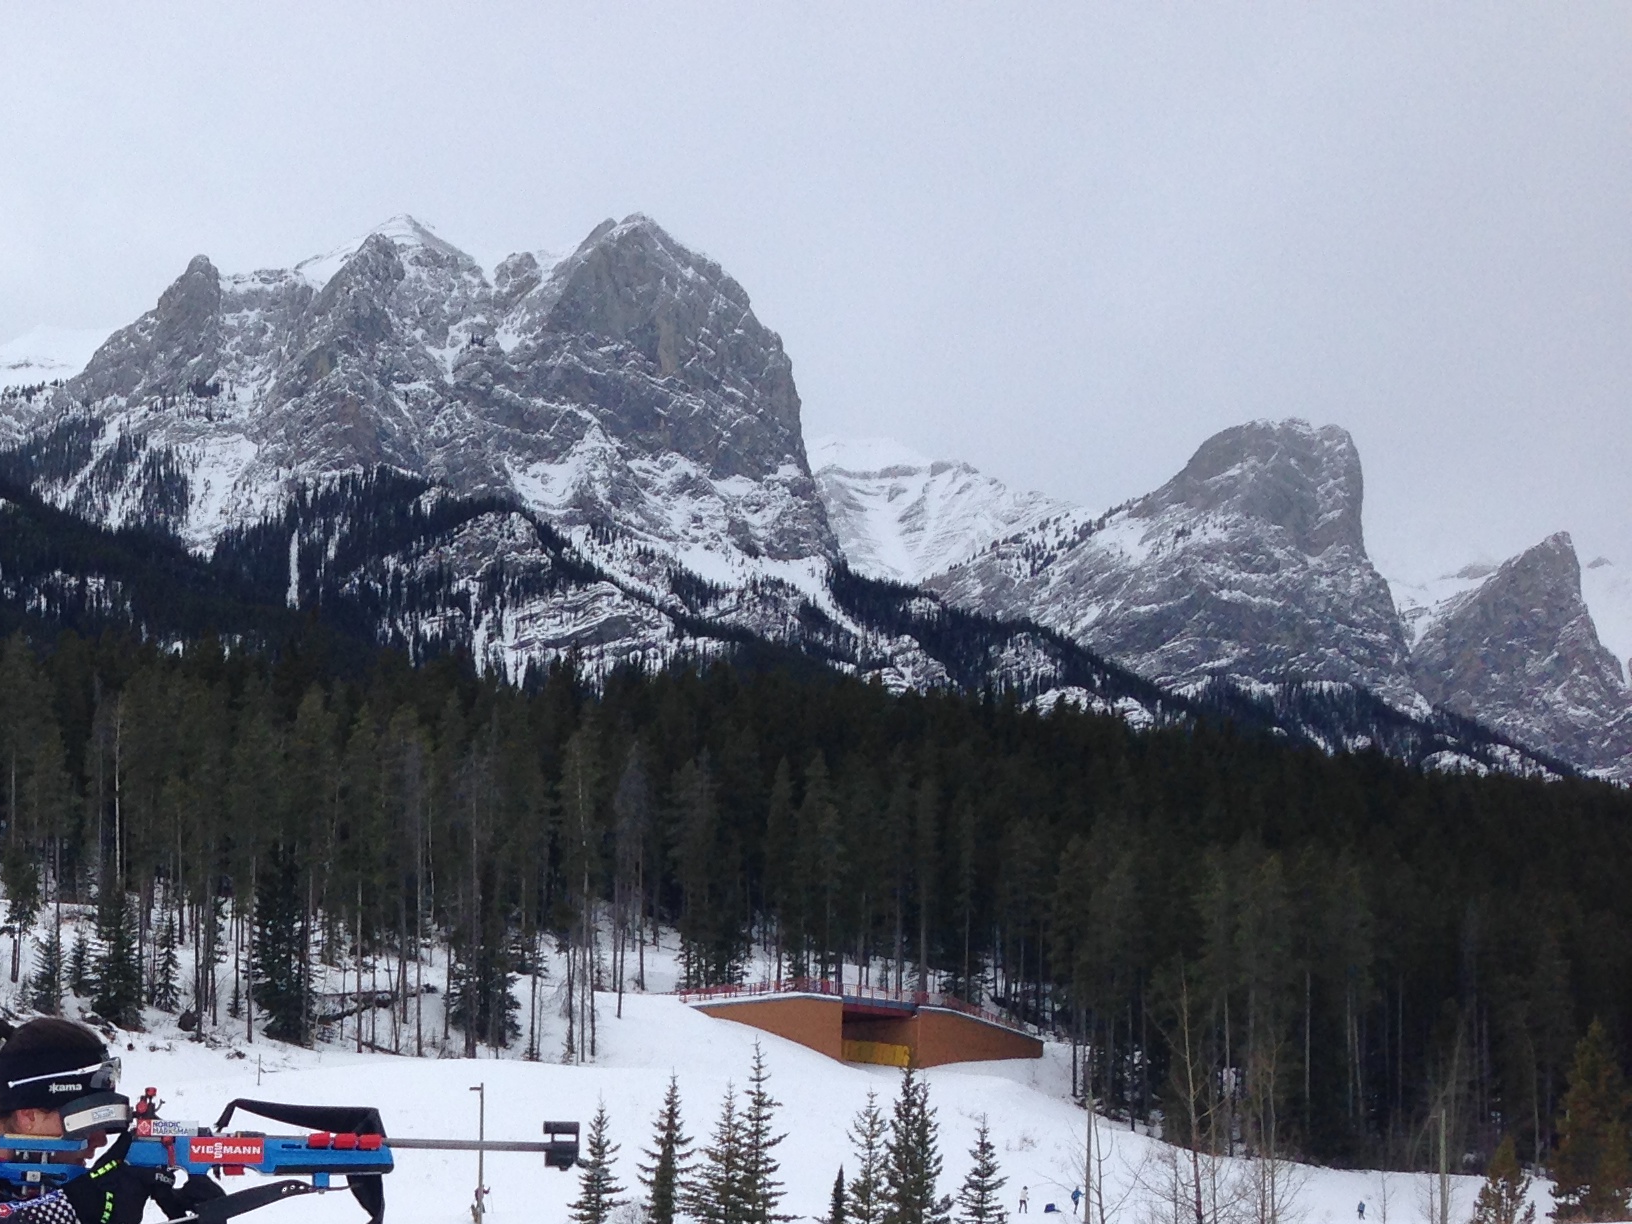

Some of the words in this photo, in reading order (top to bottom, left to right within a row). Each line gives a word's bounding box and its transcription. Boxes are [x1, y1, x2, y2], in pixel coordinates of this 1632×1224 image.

[50, 1082, 83, 1094] kama
[190, 1142, 261, 1159] VIESSMANN
[89, 1160, 118, 1179] LEKI
[100, 1191, 114, 1224] LEKI
